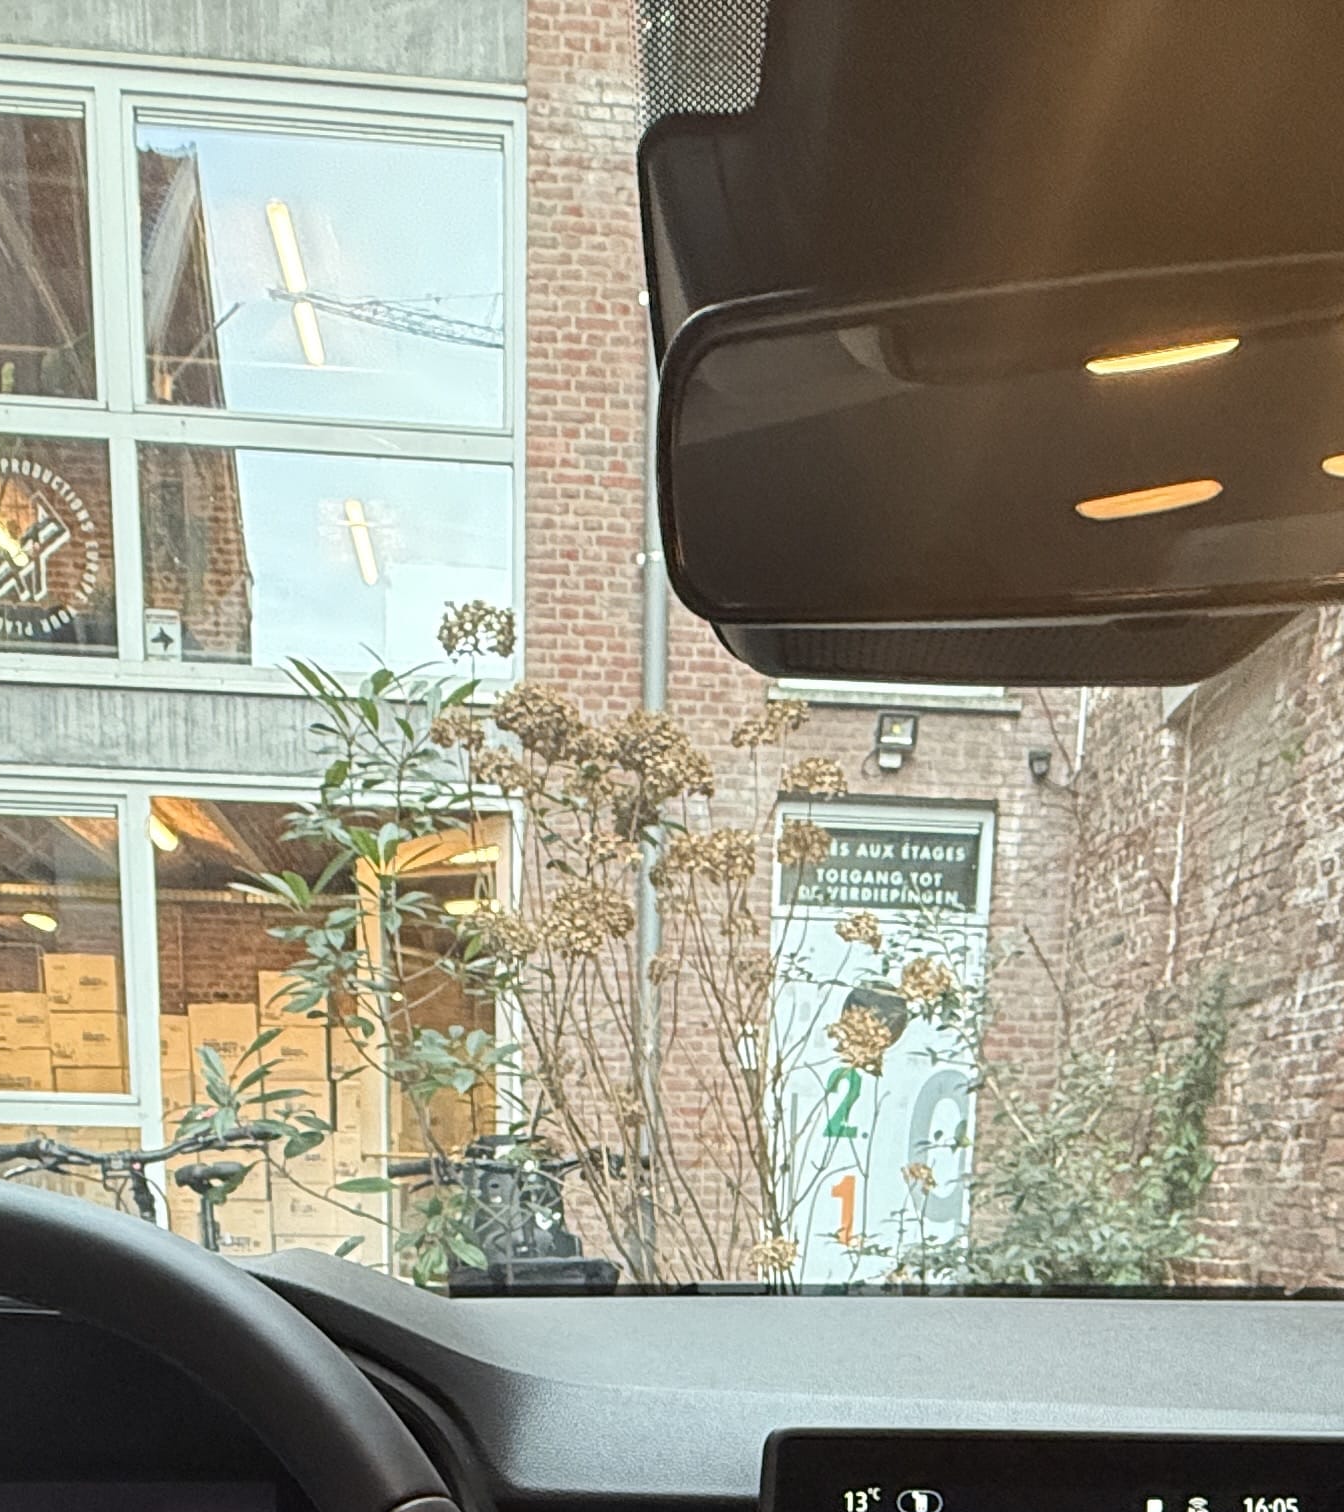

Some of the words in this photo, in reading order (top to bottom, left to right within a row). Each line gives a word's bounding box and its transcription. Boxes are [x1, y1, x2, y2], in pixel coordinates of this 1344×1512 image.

[0, 458, 94, 532] PRODUCTIONS
[857, 843, 895, 859] AUX
[901, 841, 966, 863] ÉTAGES
[816, 867, 904, 886] TOEGANG
[910, 872, 943, 888] TOT
[831, 1175, 856, 1245] 1
